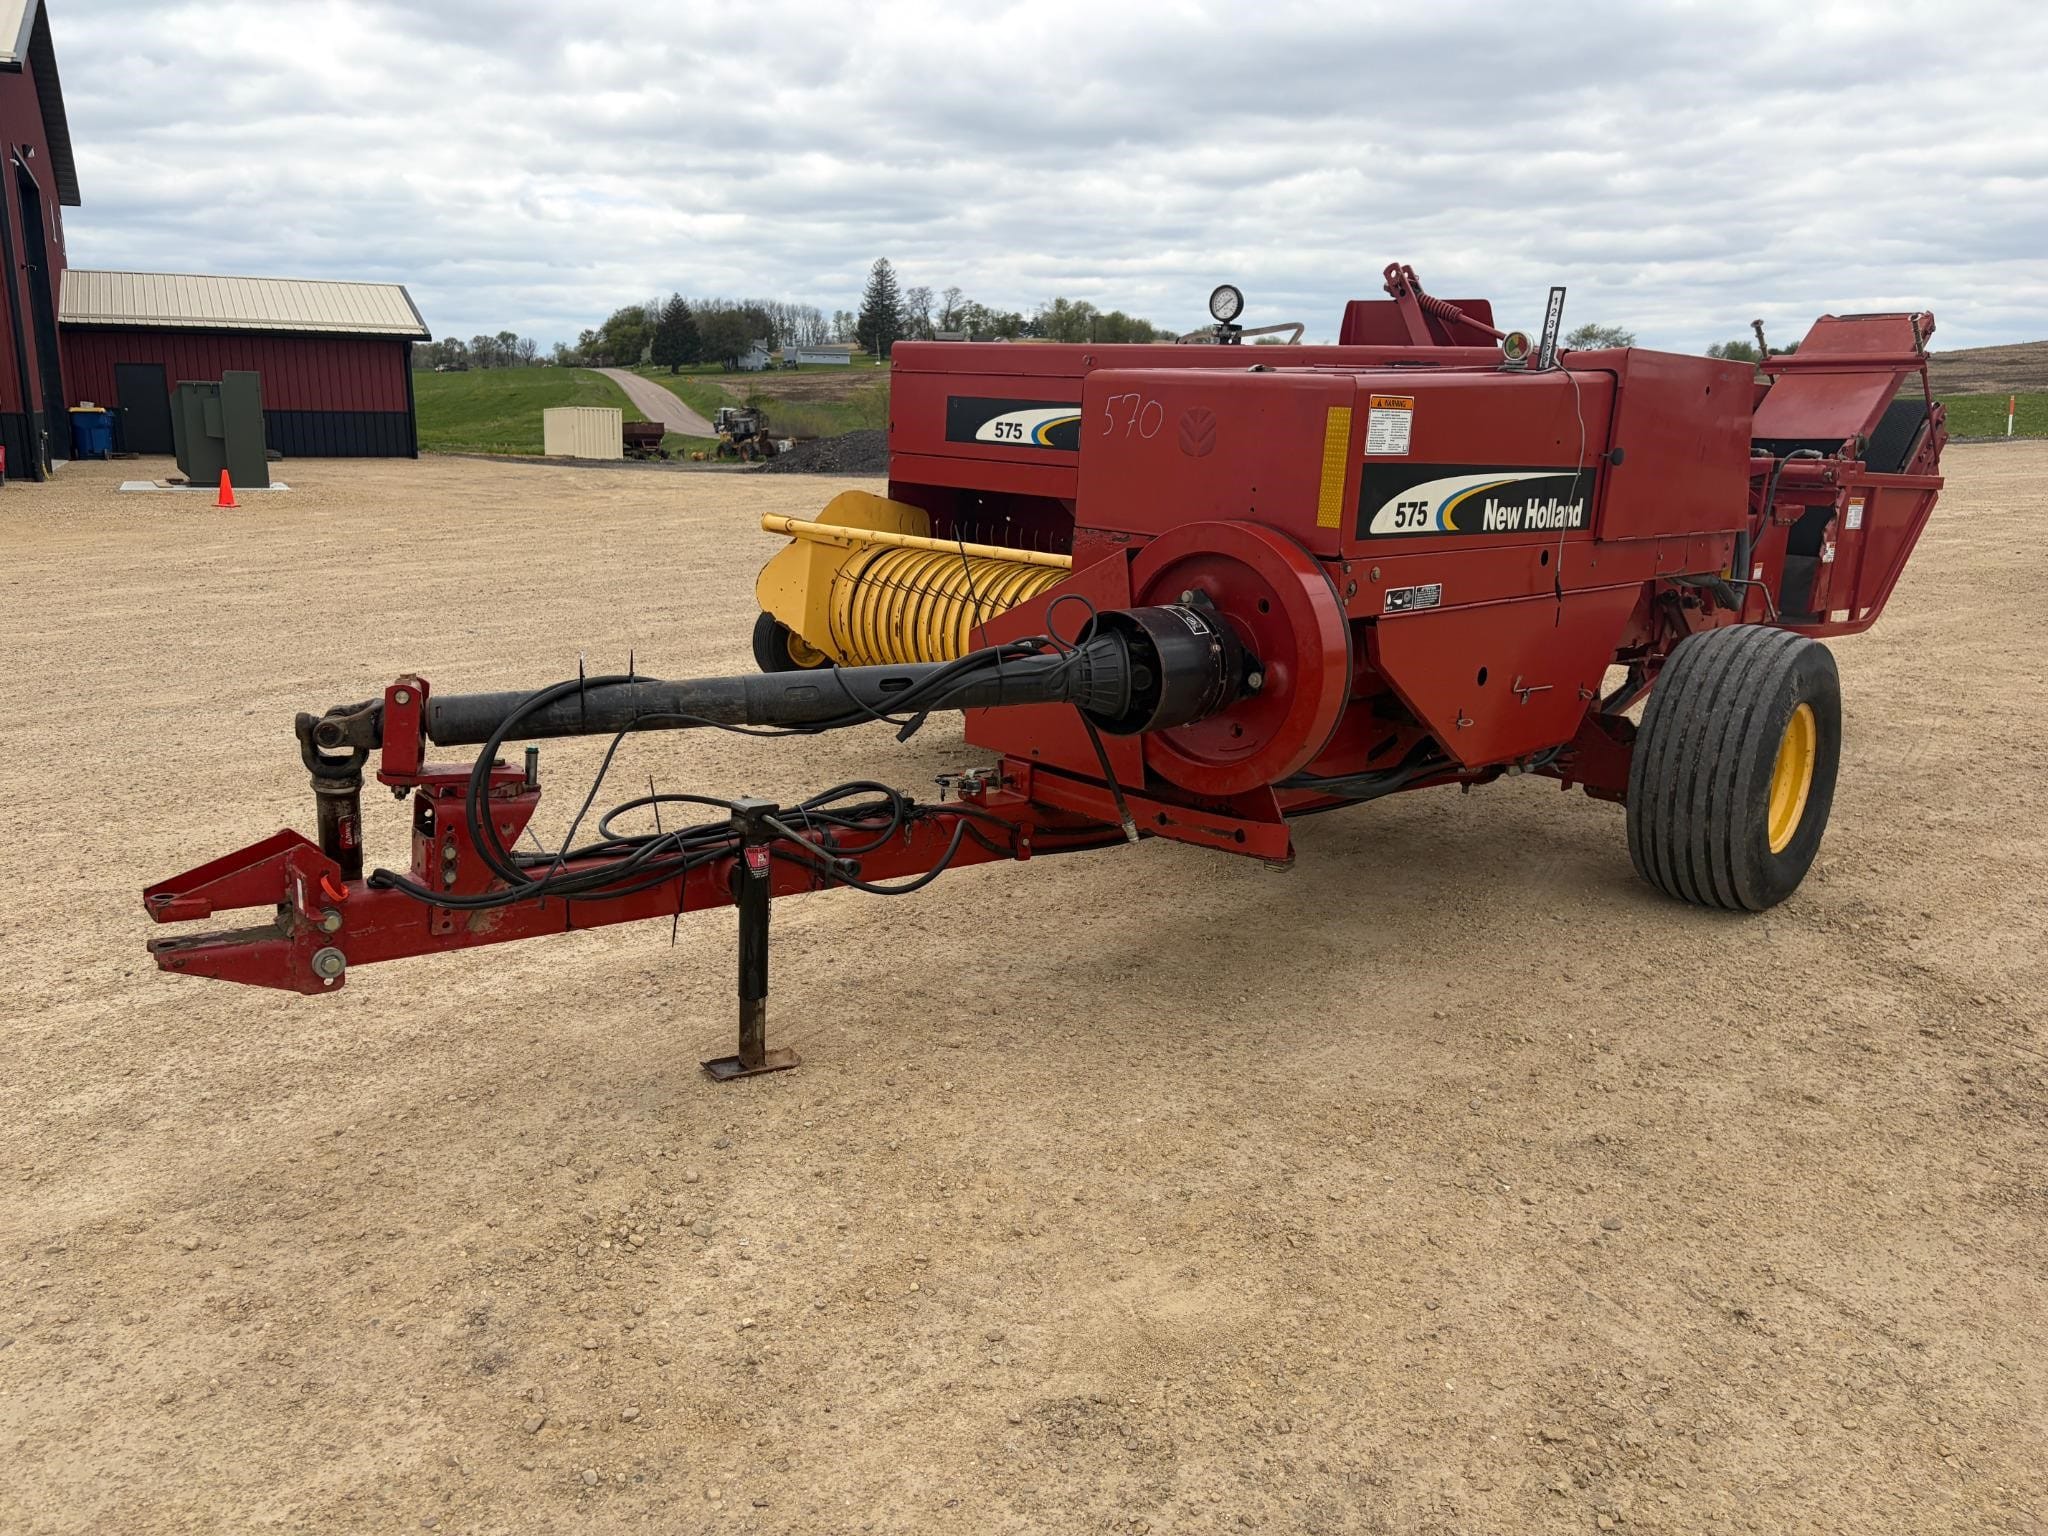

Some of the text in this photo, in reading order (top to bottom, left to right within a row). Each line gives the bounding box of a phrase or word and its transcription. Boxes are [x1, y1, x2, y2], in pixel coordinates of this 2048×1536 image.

[1549, 320, 1555, 328] 3
[1551, 308, 1557, 317] 2
[1103, 393, 1163, 439] 570
[994, 421, 1023, 440] 575
[1394, 500, 1429, 528] 575
[1482, 497, 1584, 530] New Holland
